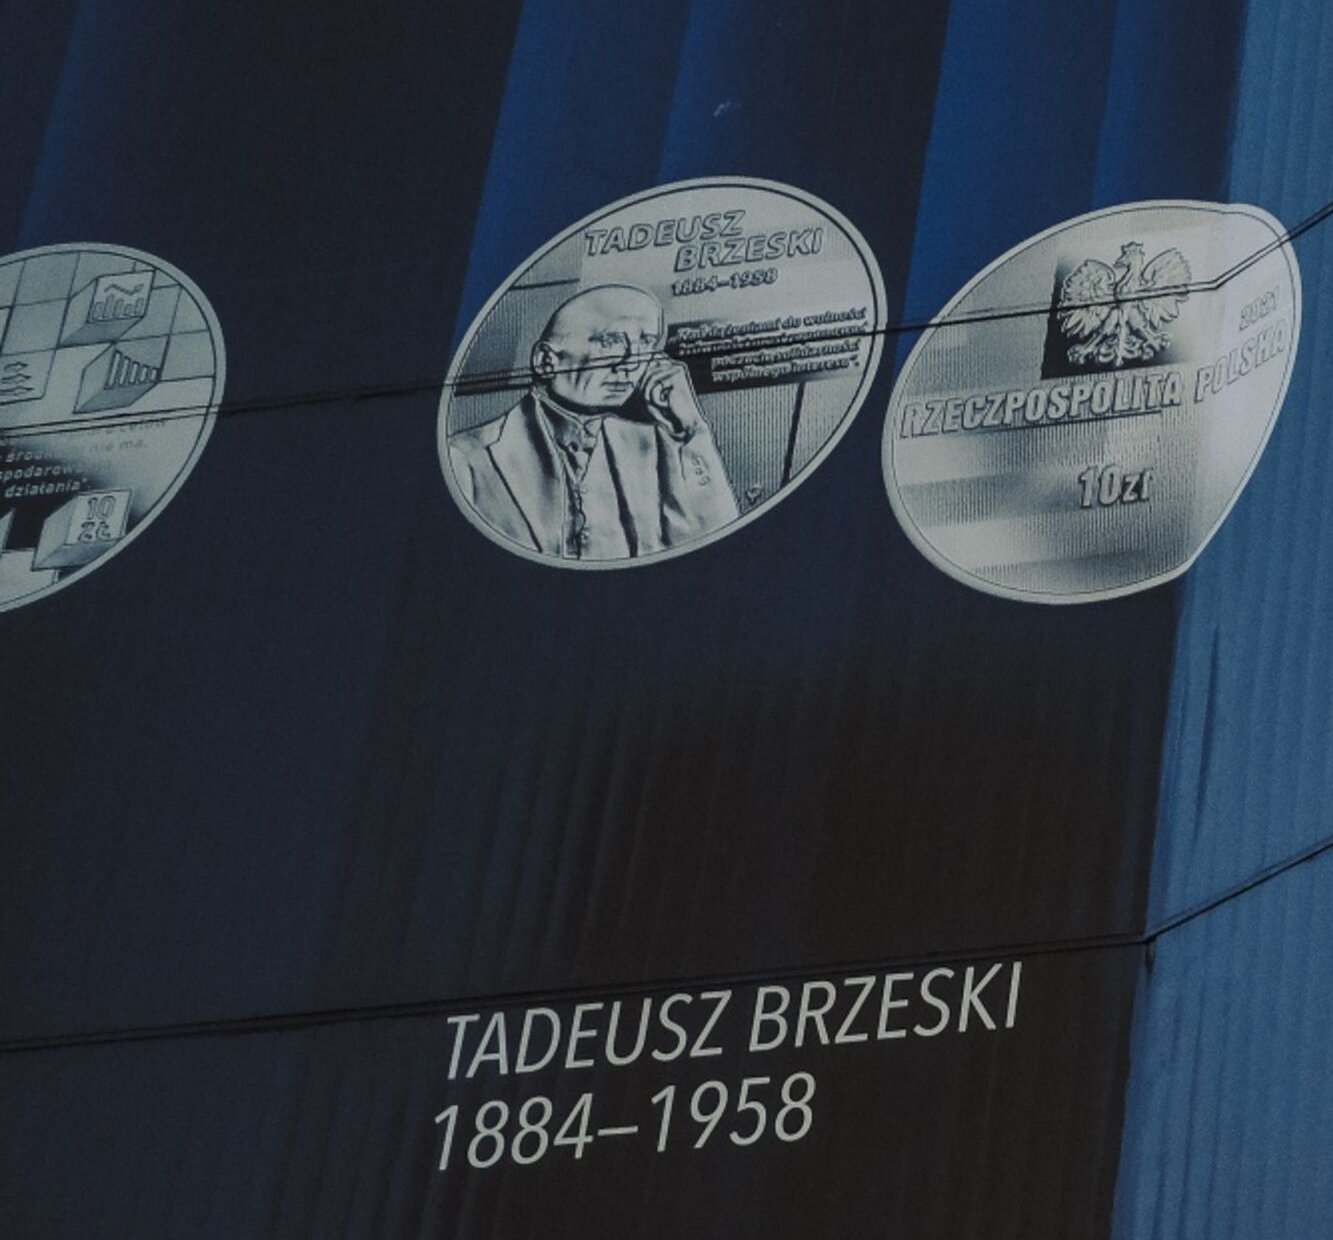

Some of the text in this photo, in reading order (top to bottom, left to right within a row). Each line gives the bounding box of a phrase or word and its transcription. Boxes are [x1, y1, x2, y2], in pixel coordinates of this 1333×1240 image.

[583, 208, 748, 258] TADEUSZ
[673, 227, 824, 273] BRZESKI
[1194, 318, 1290, 404] POLSKA
[899, 370, 1184, 438] RZECZPOSPOLITA
[88, 494, 117, 520] 10
[446, 961, 1023, 1080] TADEUSZ BRZESKI
[434, 1073, 816, 1172] 1884–1958
